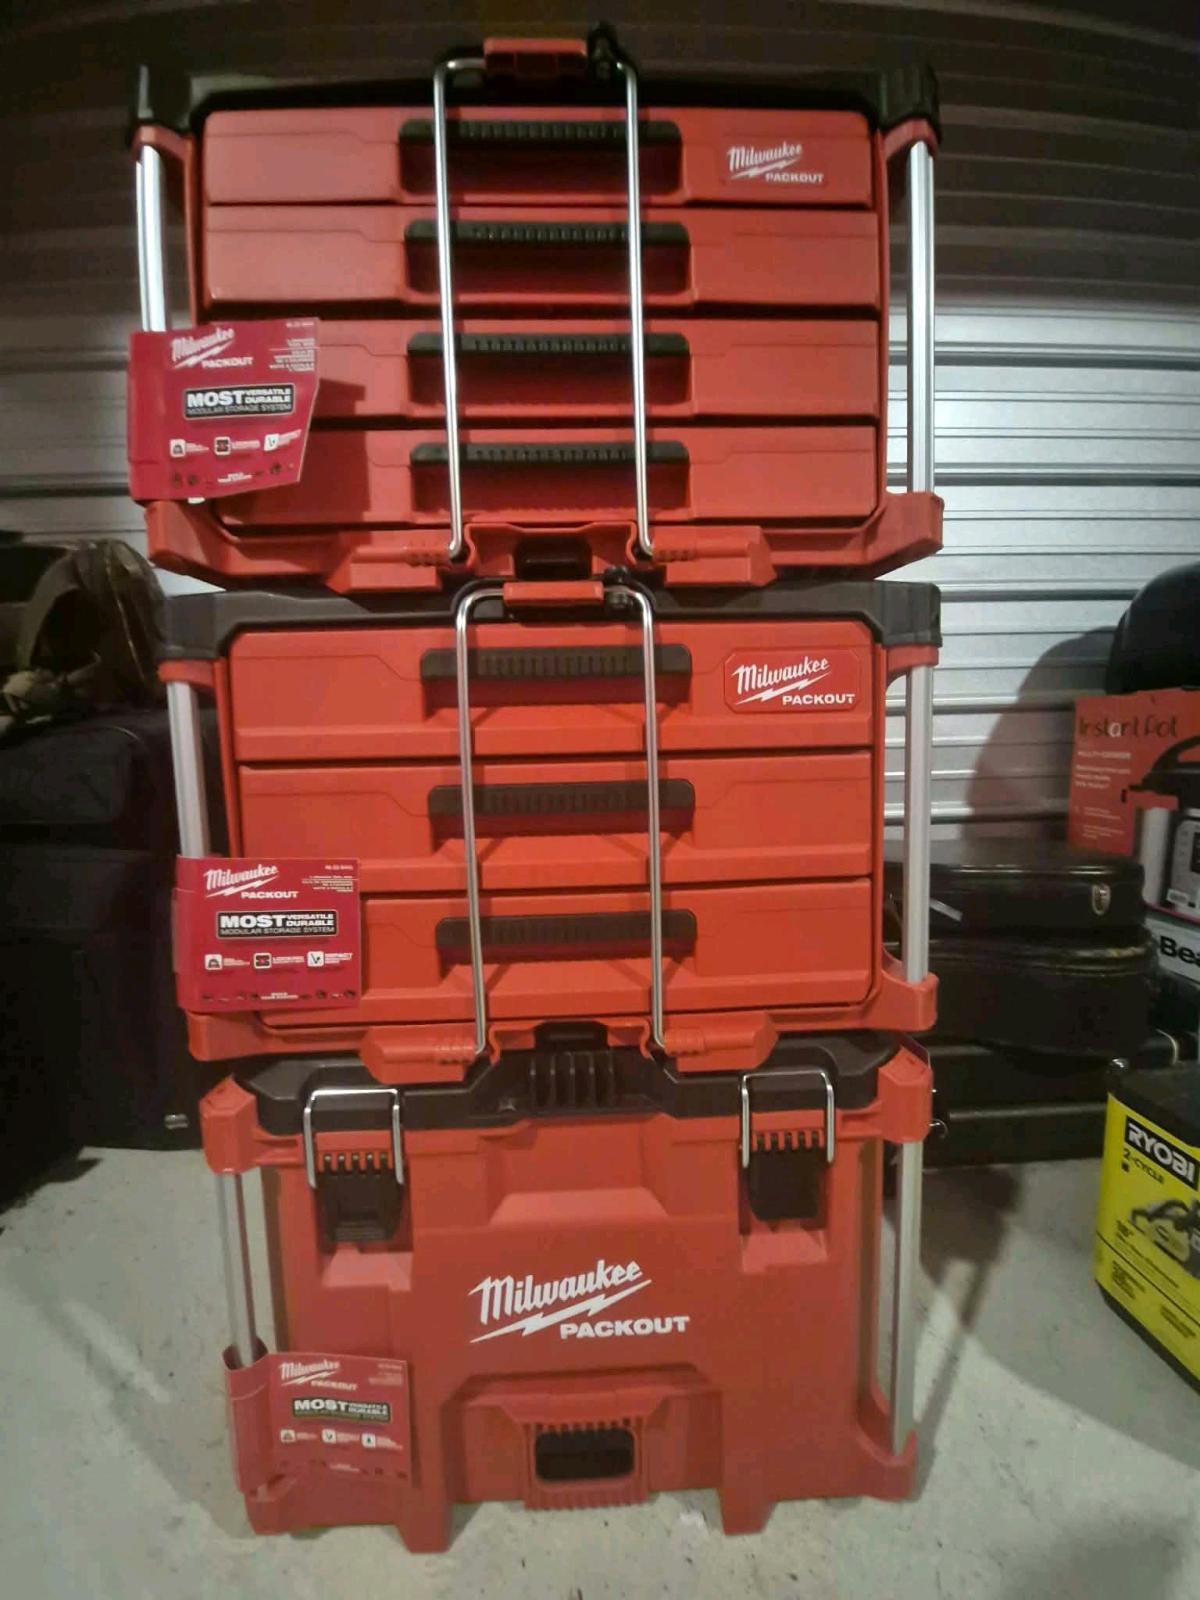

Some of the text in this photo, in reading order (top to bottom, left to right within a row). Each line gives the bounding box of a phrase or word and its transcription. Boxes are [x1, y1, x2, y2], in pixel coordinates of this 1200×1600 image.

[727, 141, 802, 172] Milwaukee
[765, 172, 824, 184] PACKOUT
[202, 356, 254, 369] PACKOUT
[187, 390, 246, 409] MOST
[731, 656, 831, 695] Milwaukee
[782, 693, 856, 706] PACKOUT
[203, 864, 279, 891] Milwaukee
[240, 890, 299, 900] PACKOUT
[220, 913, 334, 929] MOST VERSATILE
[286, 919, 335, 927] DURABLE
[220, 926, 335, 936] MODULAR STORAGE SYSTEM
[1128, 1122, 1196, 1183] RYOBI
[468, 1259, 643, 1325] Milwaukee
[560, 1315, 691, 1340] PACKOUT
[294, 1398, 349, 1412] MOST
